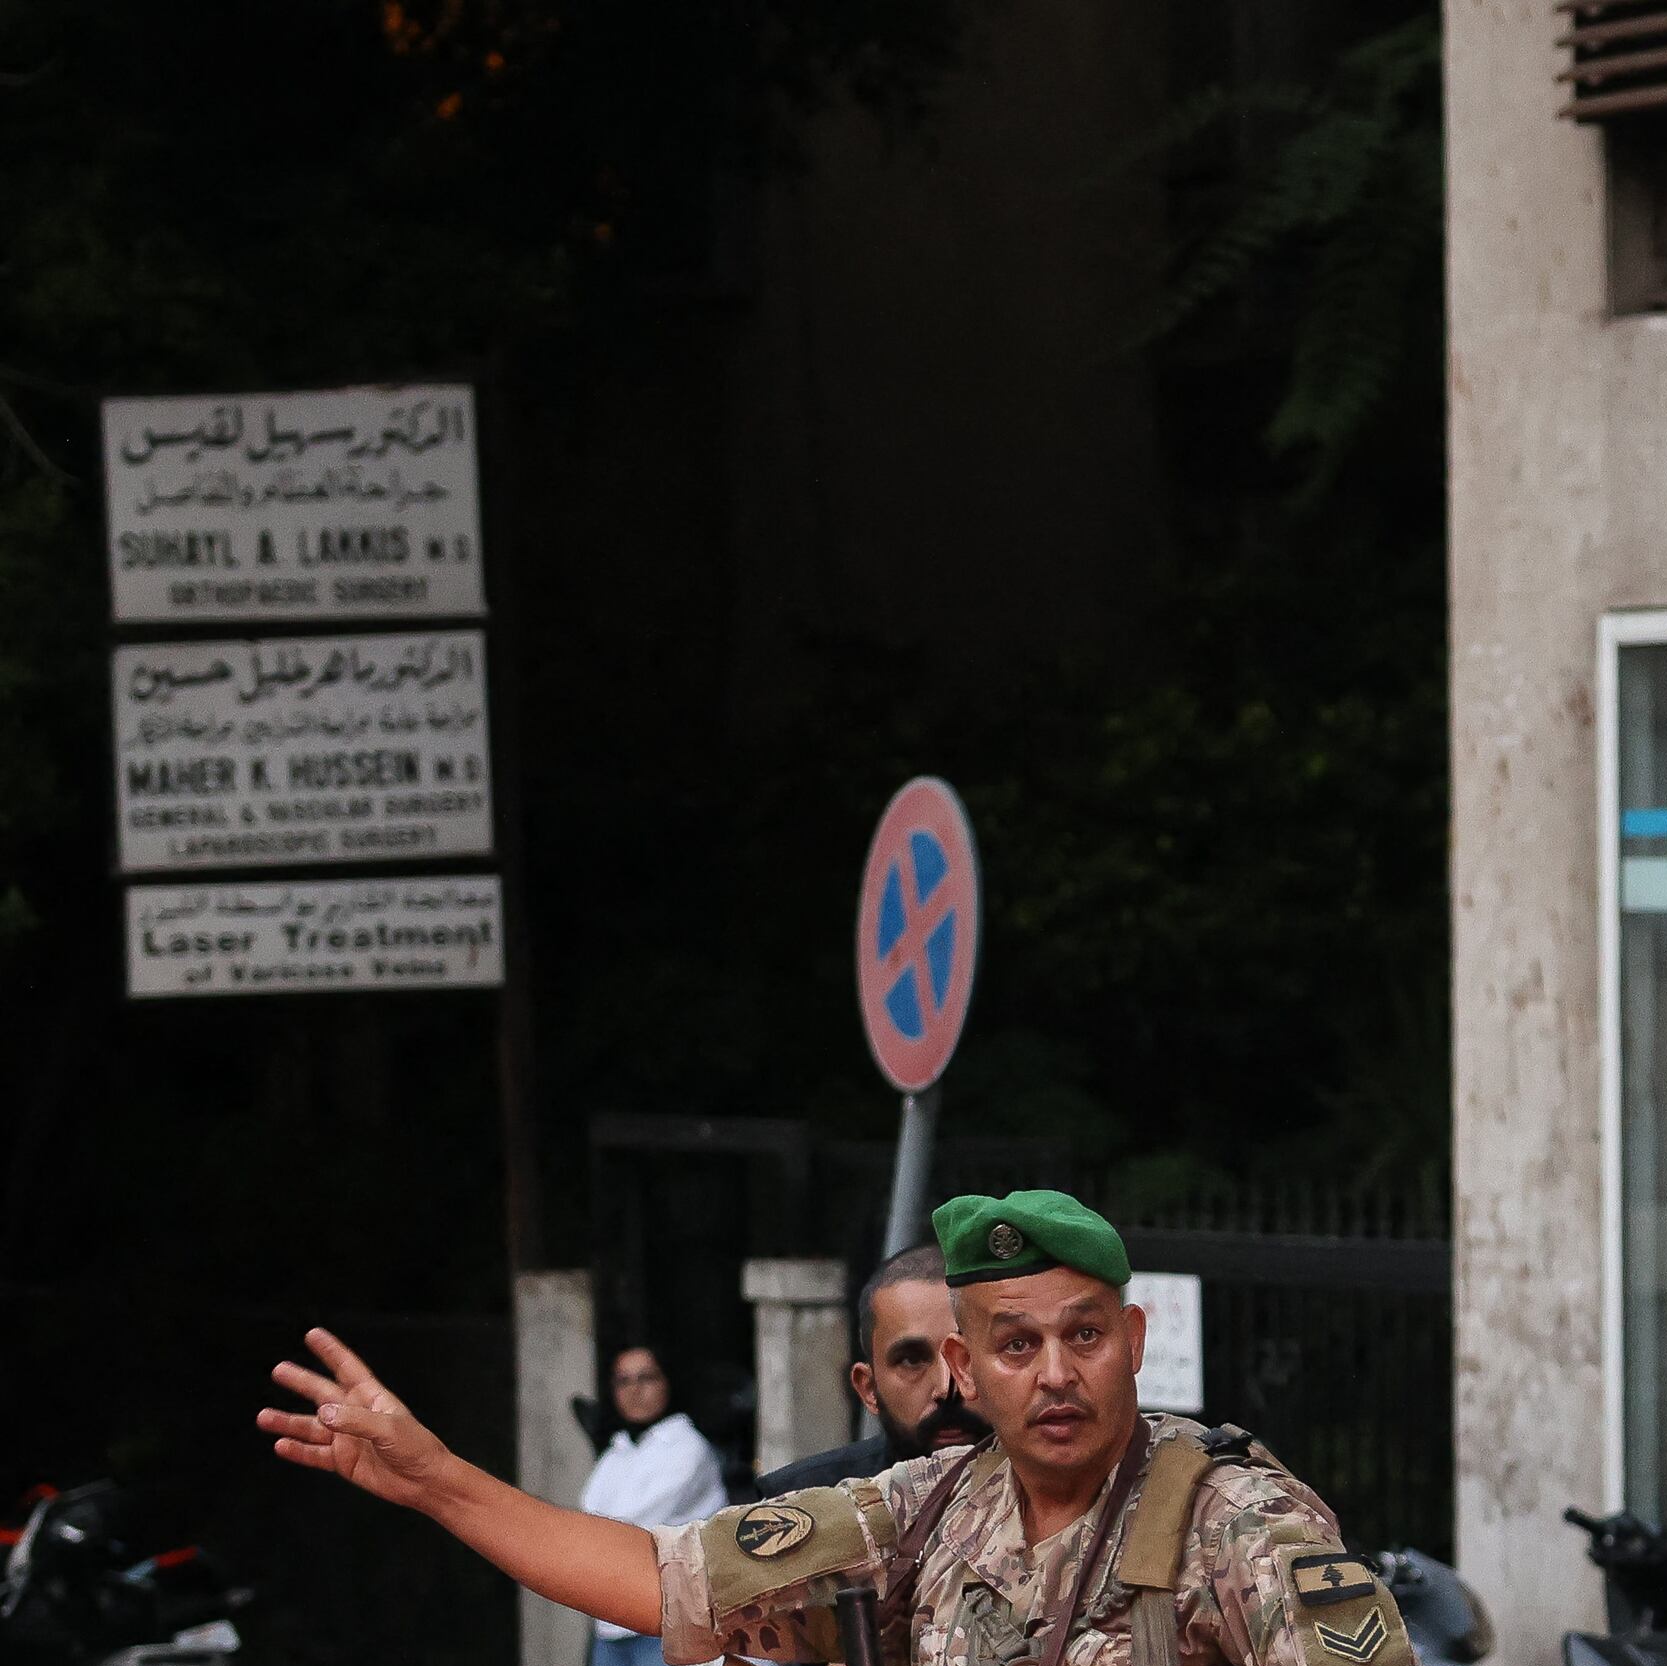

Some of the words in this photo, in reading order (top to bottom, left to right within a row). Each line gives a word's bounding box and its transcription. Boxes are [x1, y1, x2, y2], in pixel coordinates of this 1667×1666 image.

[127, 757, 237, 796] MAHER
[288, 749, 421, 789] HUSSEIN
[142, 930, 254, 958] Laser
[282, 915, 493, 952] Treatment
